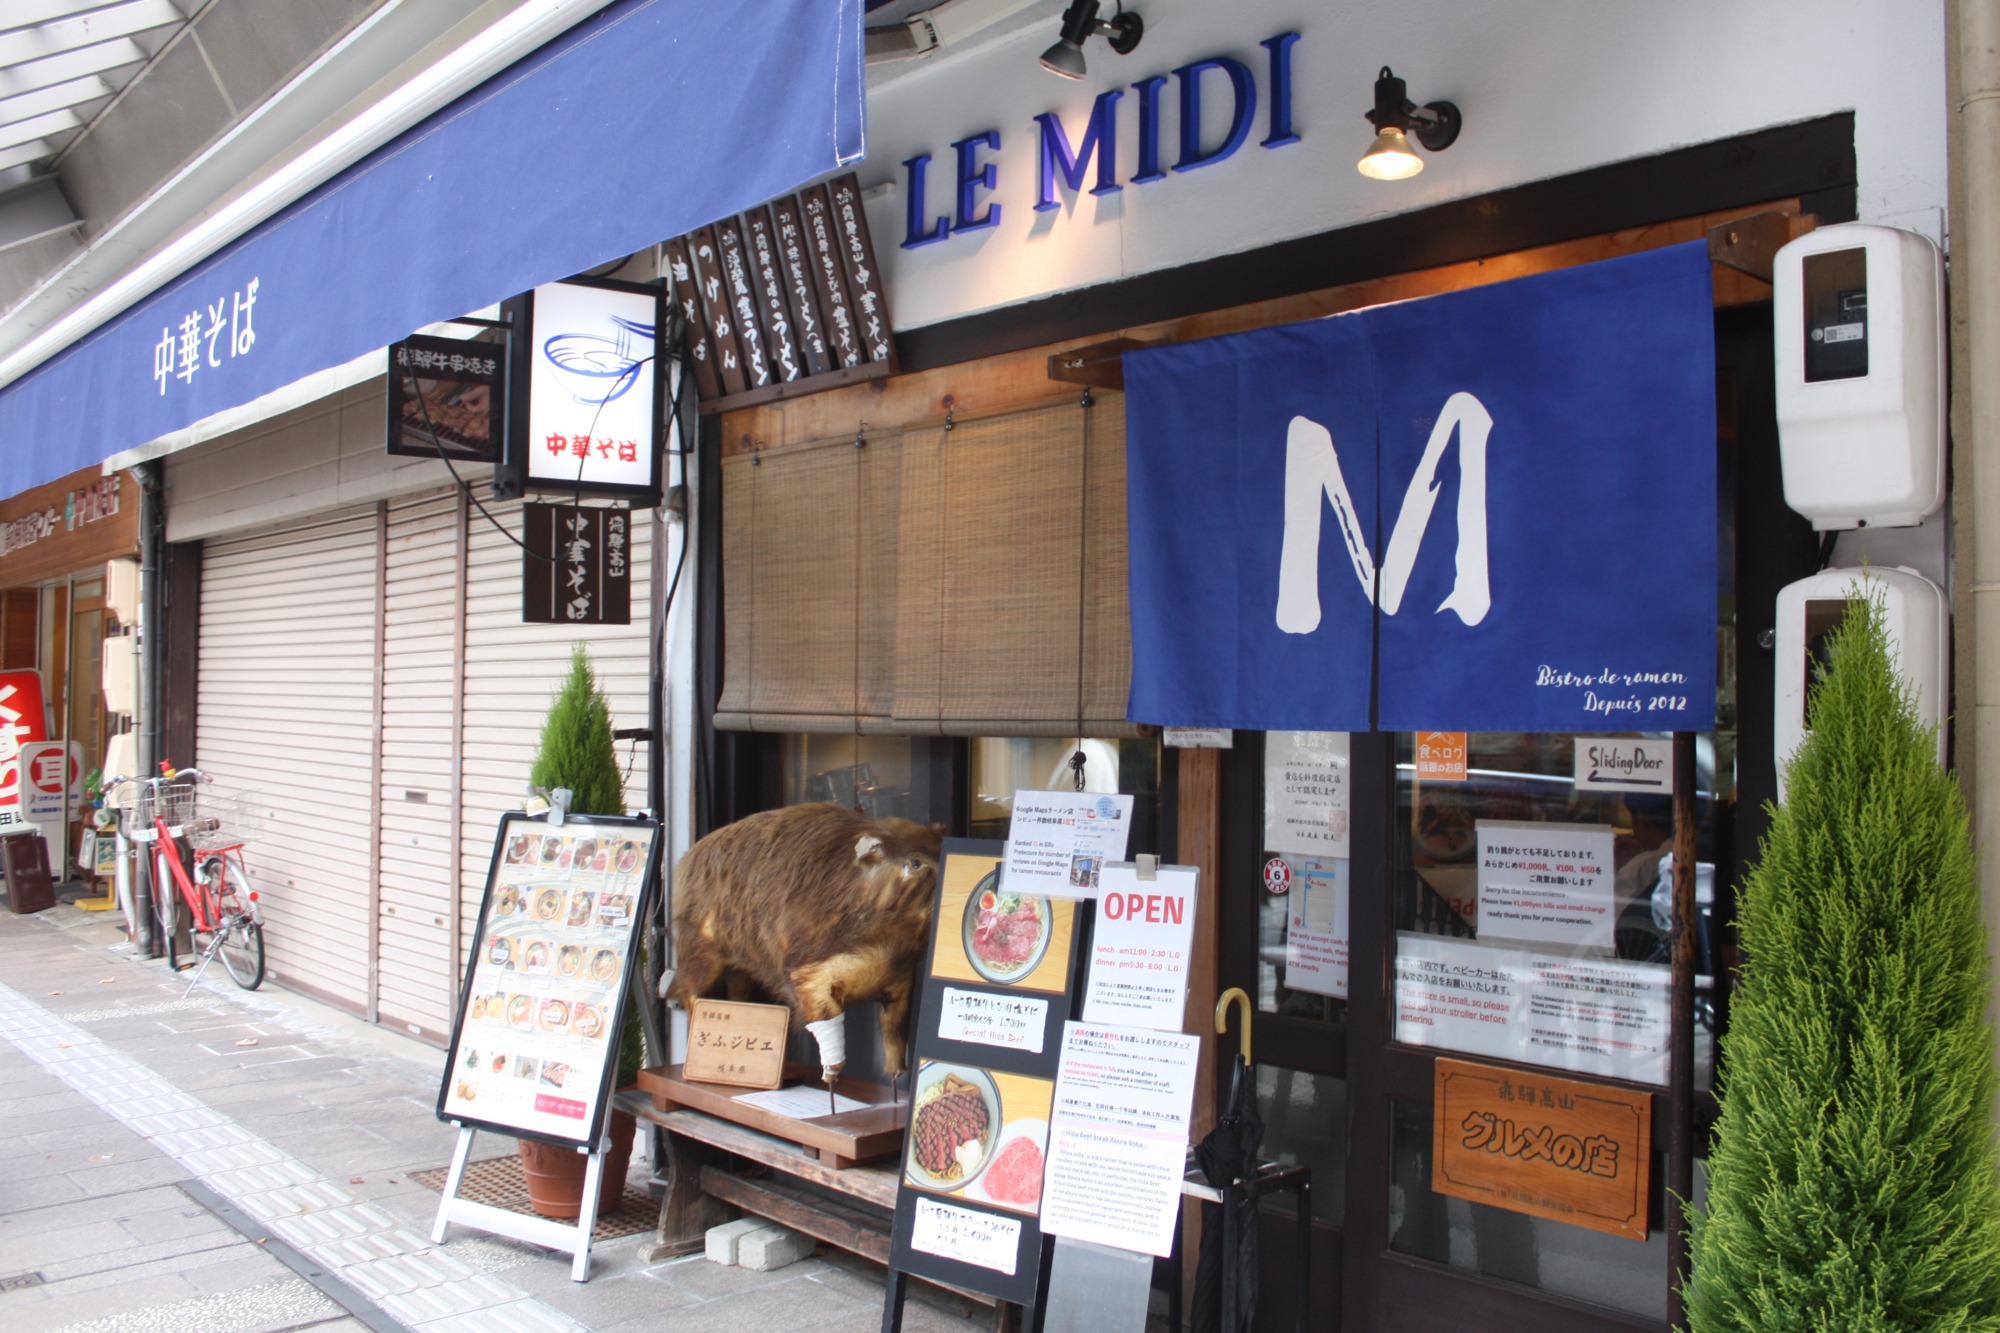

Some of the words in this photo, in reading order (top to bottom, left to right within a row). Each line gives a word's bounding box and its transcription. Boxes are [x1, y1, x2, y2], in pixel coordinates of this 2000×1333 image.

[901, 129, 1001, 250] LE
[1033, 31, 1301, 212] MIDI
[699, 245, 736, 369] つけめん
[154, 276, 259, 396] 中華そば
[546, 432, 638, 463] 中華そば
[1276, 391, 1494, 634] M
[566, 512, 592, 620] 中華そば
[1536, 665, 1596, 687] Bistro
[1598, 667, 1621, 684] de
[1623, 672, 1688, 686] ramen
[1583, 690, 1642, 716] Depuis
[1648, 696, 1687, 710] 2012
[1419, 745, 1463, 760] 食べログ
[1419, 761, 1463, 773] 話題のお店
[1274, 871, 1281, 880] 6
[1485, 886, 1500, 894] Sorry
[1104, 892, 1184, 925] OPEN
[1481, 897, 1498, 905] Please
[1584, 905, 1605, 914] change
[1486, 910, 1502, 918] ready
[1503, 912, 1519, 920] thank
[1520, 913, 1531, 921] you
[1542, 915, 1554, 923] your
[1096, 945, 1114, 953] lunch
[1095, 958, 1115, 967] dinner
[1439, 993, 1445, 1002] is
[1471, 997, 1481, 1007] so
[1483, 999, 1509, 1011] please
[1430, 1005, 1446, 1015] your
[1449, 1007, 1477, 1019] stroller
[1479, 1012, 1506, 1024] before
[697, 1031, 774, 1051] ぎふジビエ
[1462, 1111, 1619, 1178] グルメの店
